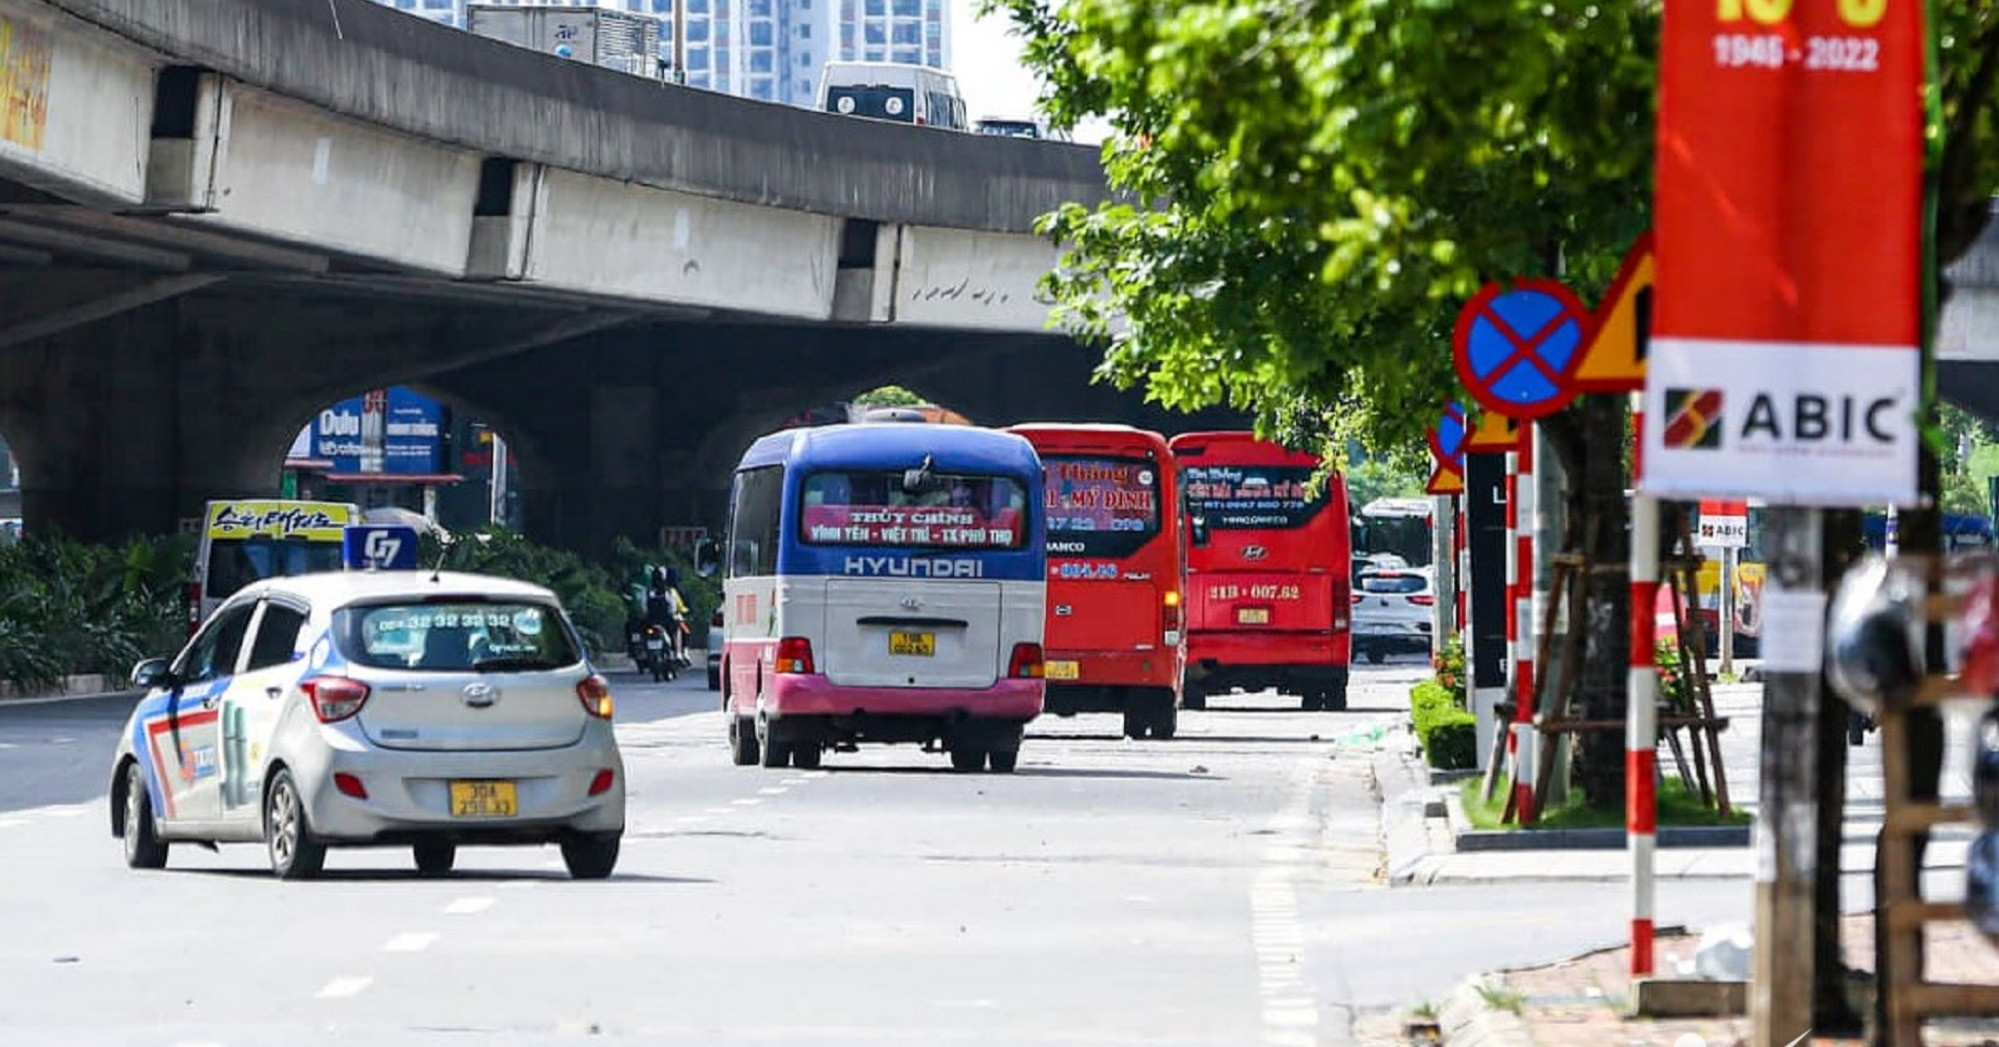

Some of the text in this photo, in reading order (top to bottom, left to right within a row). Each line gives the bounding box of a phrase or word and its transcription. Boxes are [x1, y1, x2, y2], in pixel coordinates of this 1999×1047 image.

[1713, 34, 1784, 69] 1945
[1806, 35, 1879, 71] 2022
[1741, 393, 1896, 442] ABIC
[1104, 488, 1152, 509] ĐÌNH
[1717, 525, 1743, 535] ABIC
[364, 530, 400, 567] G7
[845, 556, 983, 577] HYUNDAI
